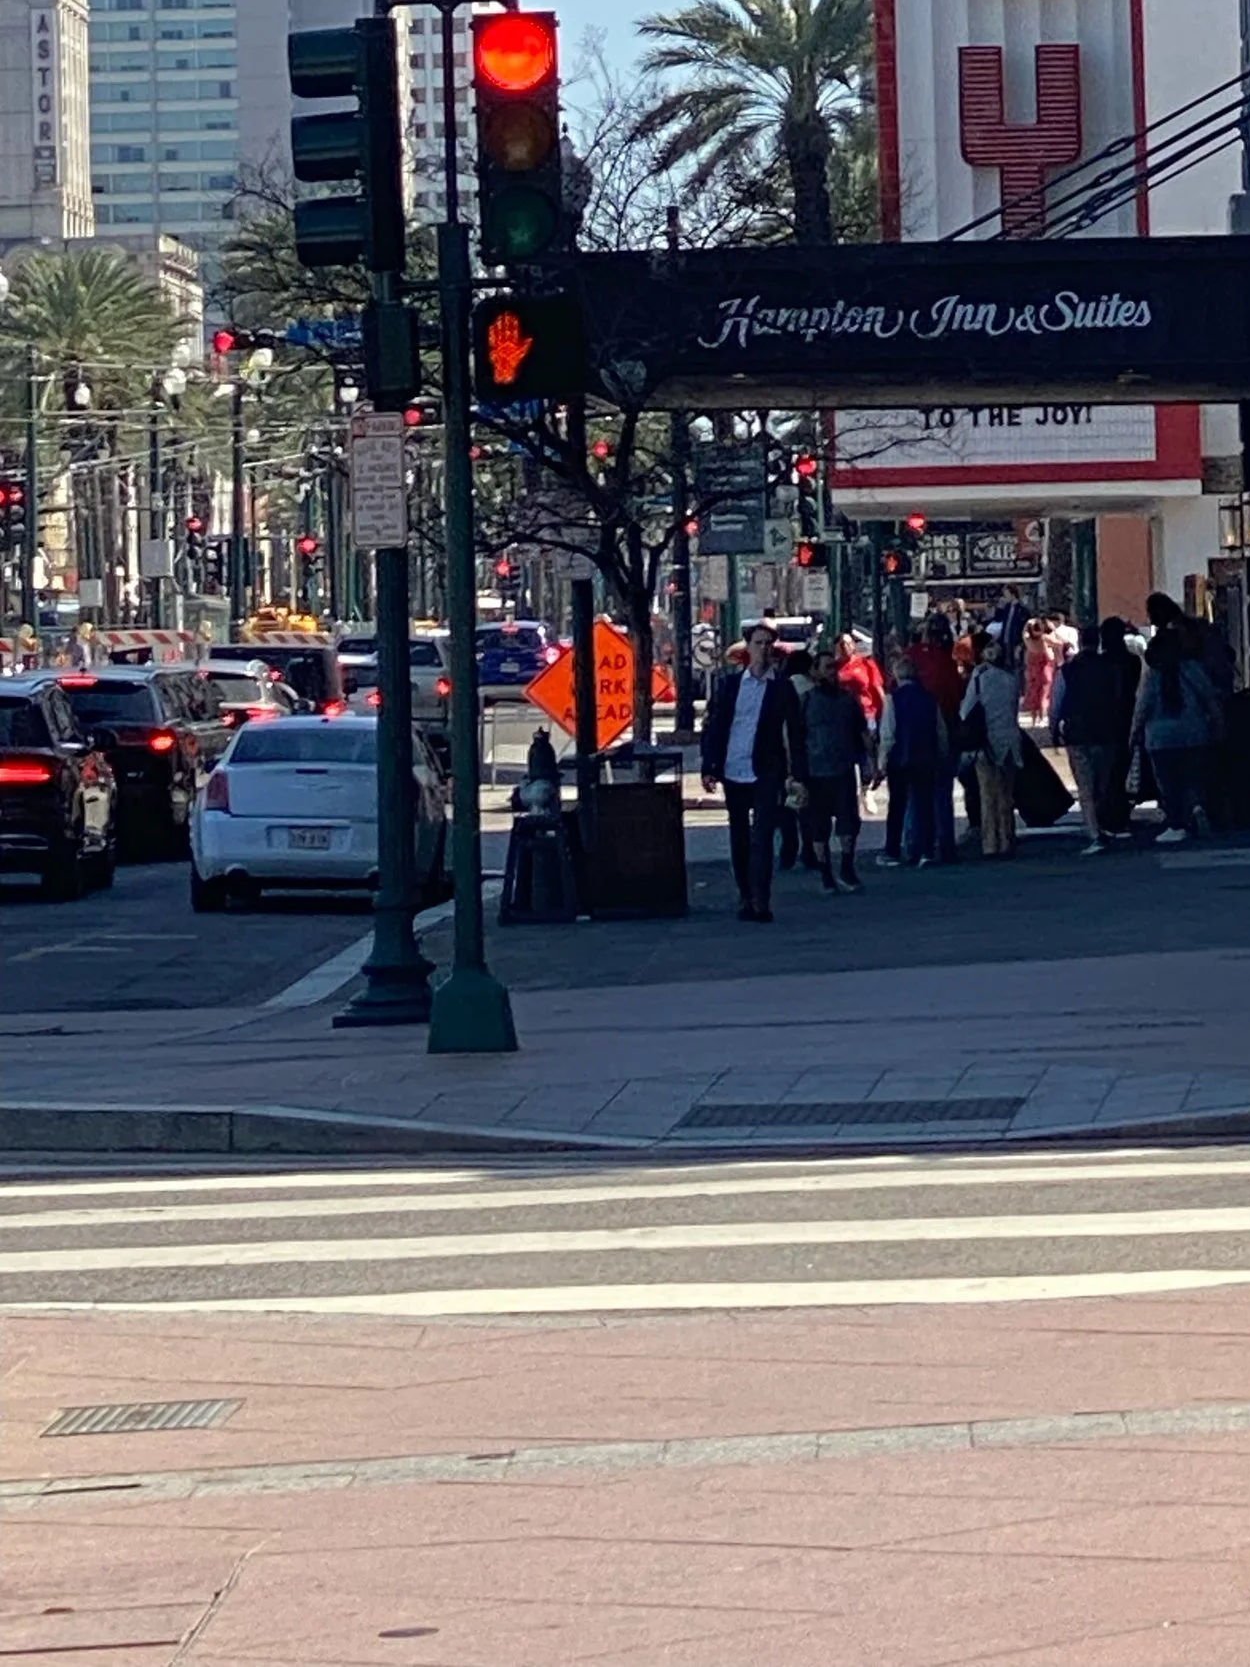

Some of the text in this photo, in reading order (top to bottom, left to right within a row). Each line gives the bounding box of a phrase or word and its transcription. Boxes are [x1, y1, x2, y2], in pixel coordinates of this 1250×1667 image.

[37, 13, 51, 141] ASTOR
[698, 290, 1152, 349] Hampton Inn & Suites
[919, 404, 1093, 430] TO THE JOY!
